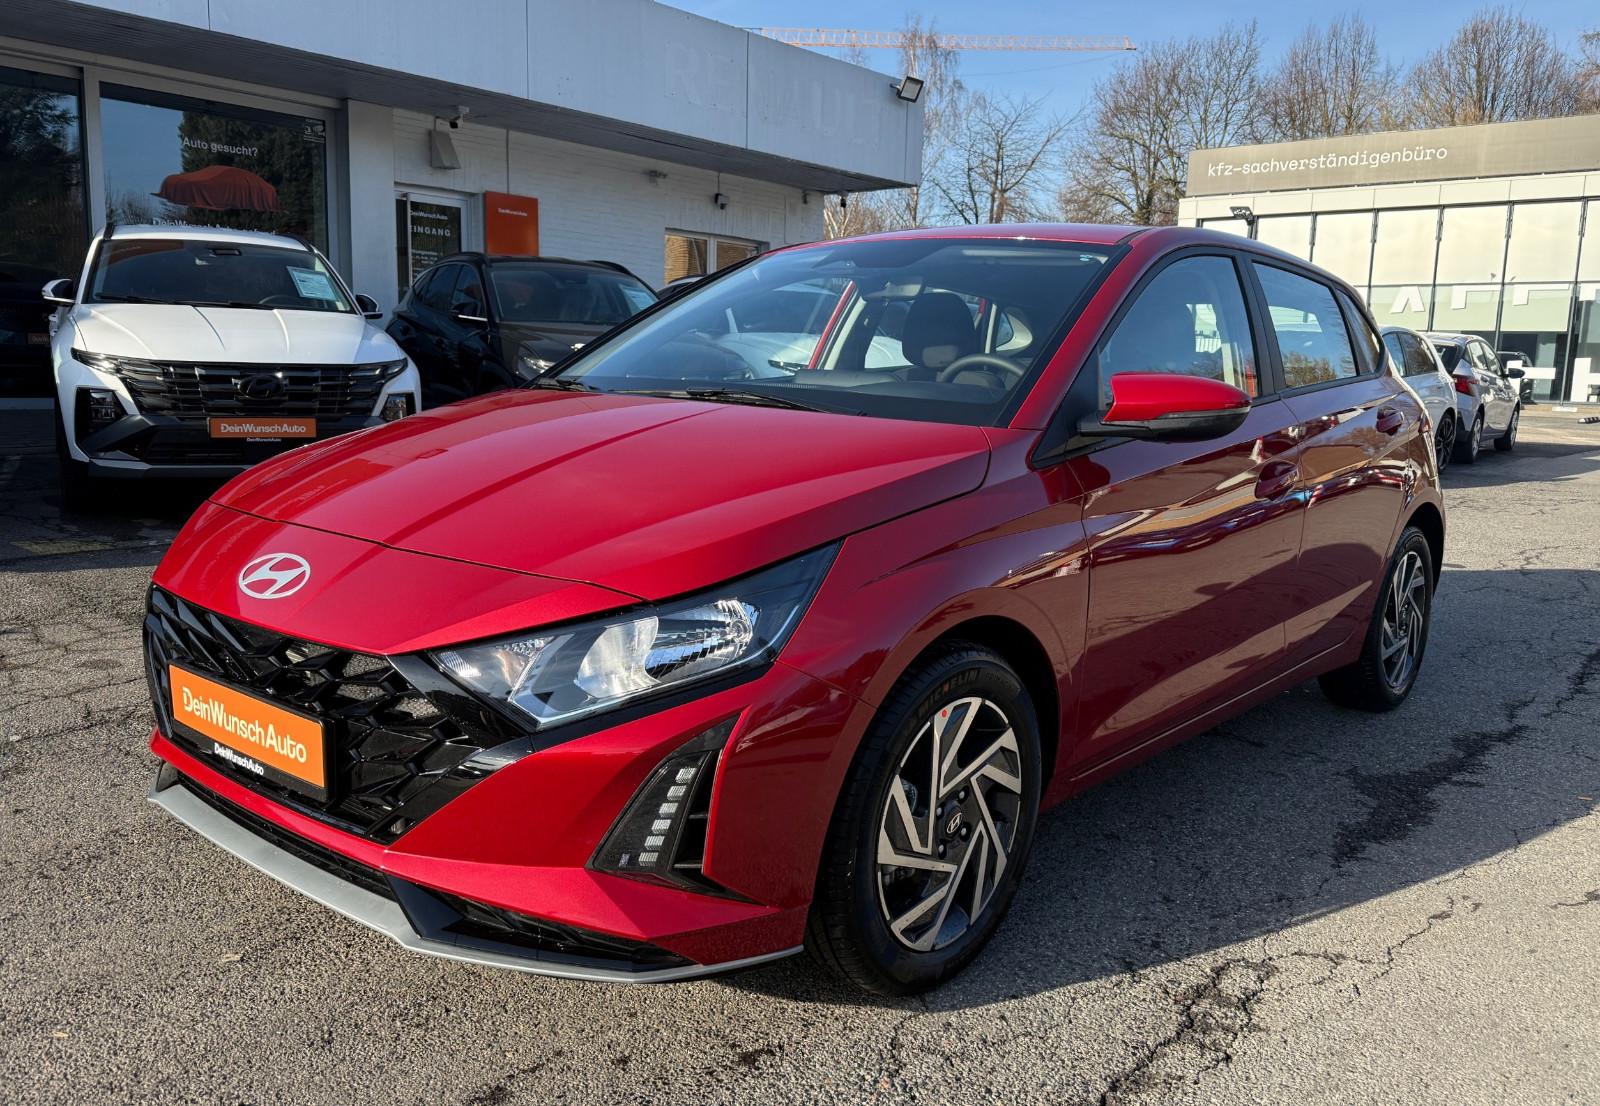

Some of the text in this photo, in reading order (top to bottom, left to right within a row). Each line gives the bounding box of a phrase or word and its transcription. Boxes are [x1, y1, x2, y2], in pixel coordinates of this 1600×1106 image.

[182, 137, 258, 157] Auto gesucht?
[1207, 146, 1448, 177] kfz-sachverständigenbüro
[220, 423, 307, 433] DeinWunschAuto
[182, 686, 307, 763] DeinWunschAuto
[214, 742, 264, 776] DeinWunschAuto
